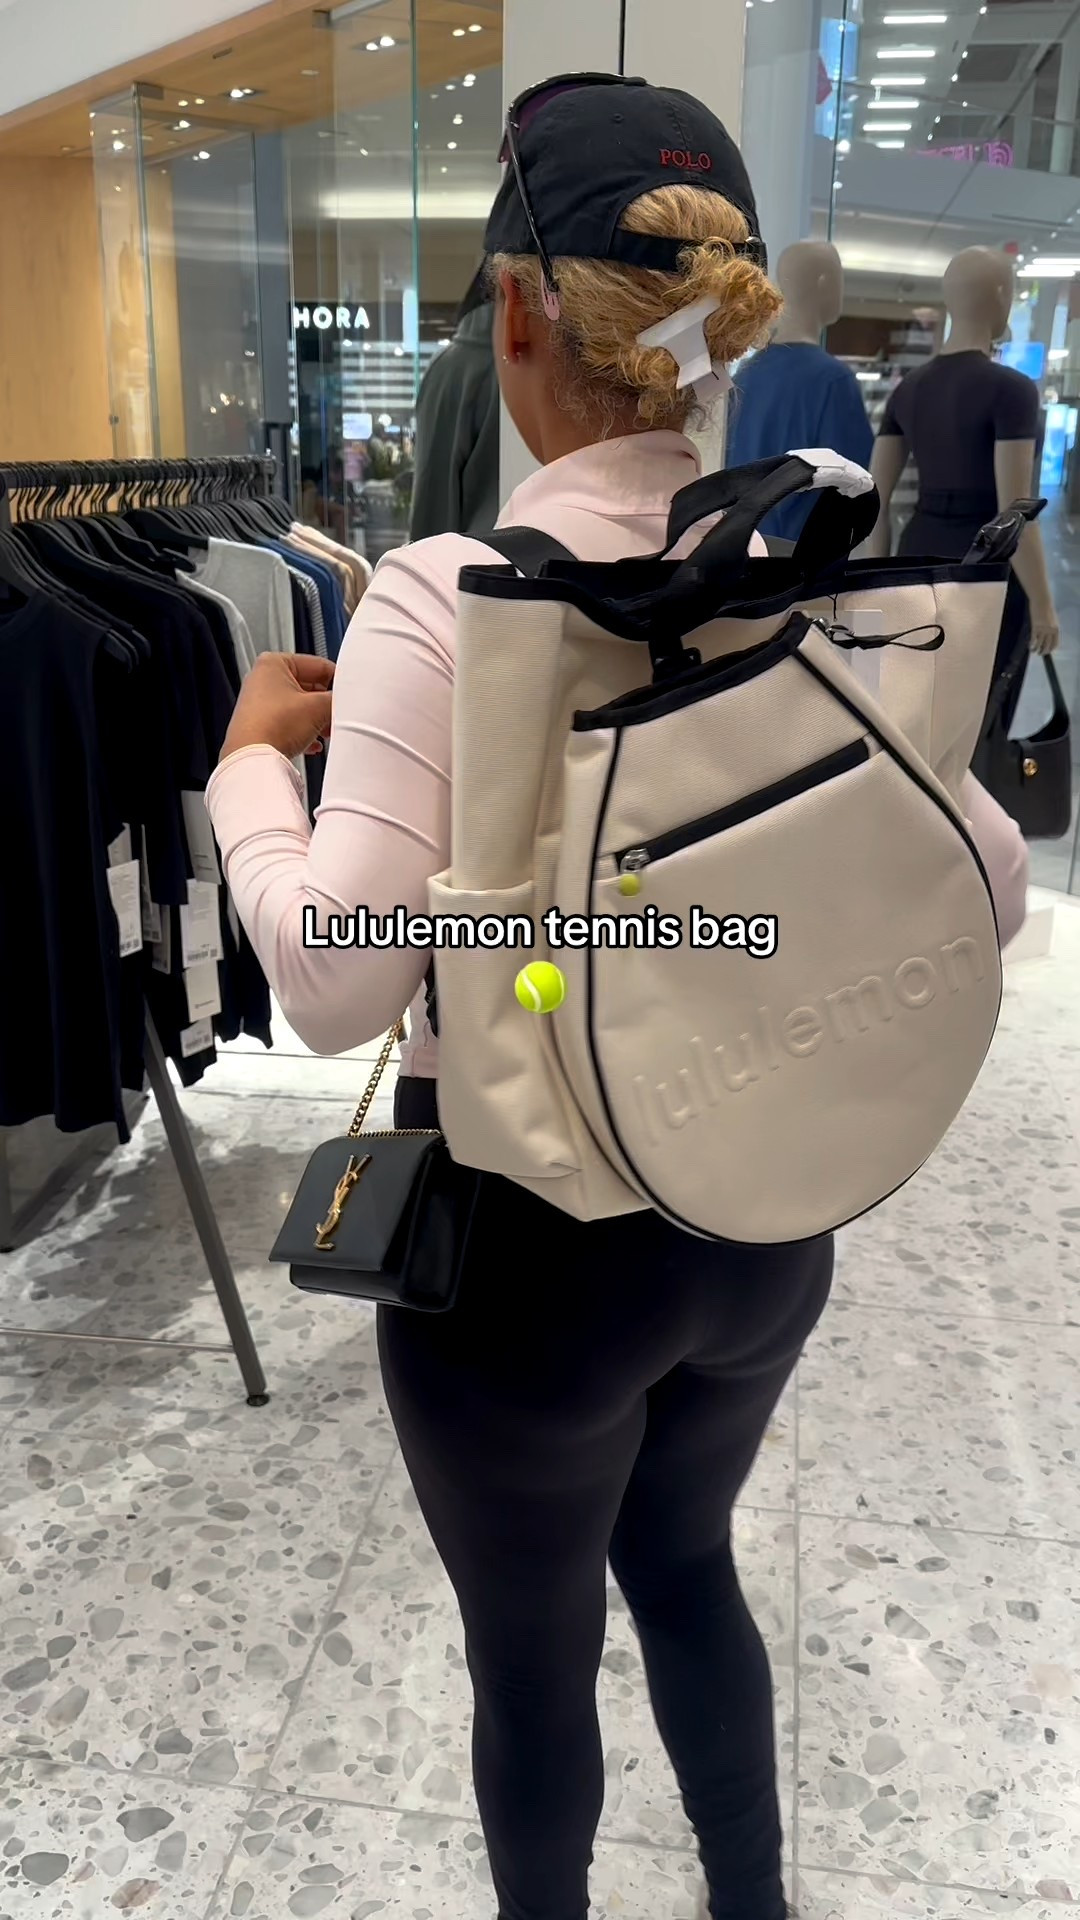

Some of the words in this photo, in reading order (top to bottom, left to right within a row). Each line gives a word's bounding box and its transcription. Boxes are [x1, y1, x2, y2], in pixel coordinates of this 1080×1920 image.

[659, 149, 712, 170] POLO
[292, 306, 370, 329] HORA
[632, 936, 985, 1146] lululemon
